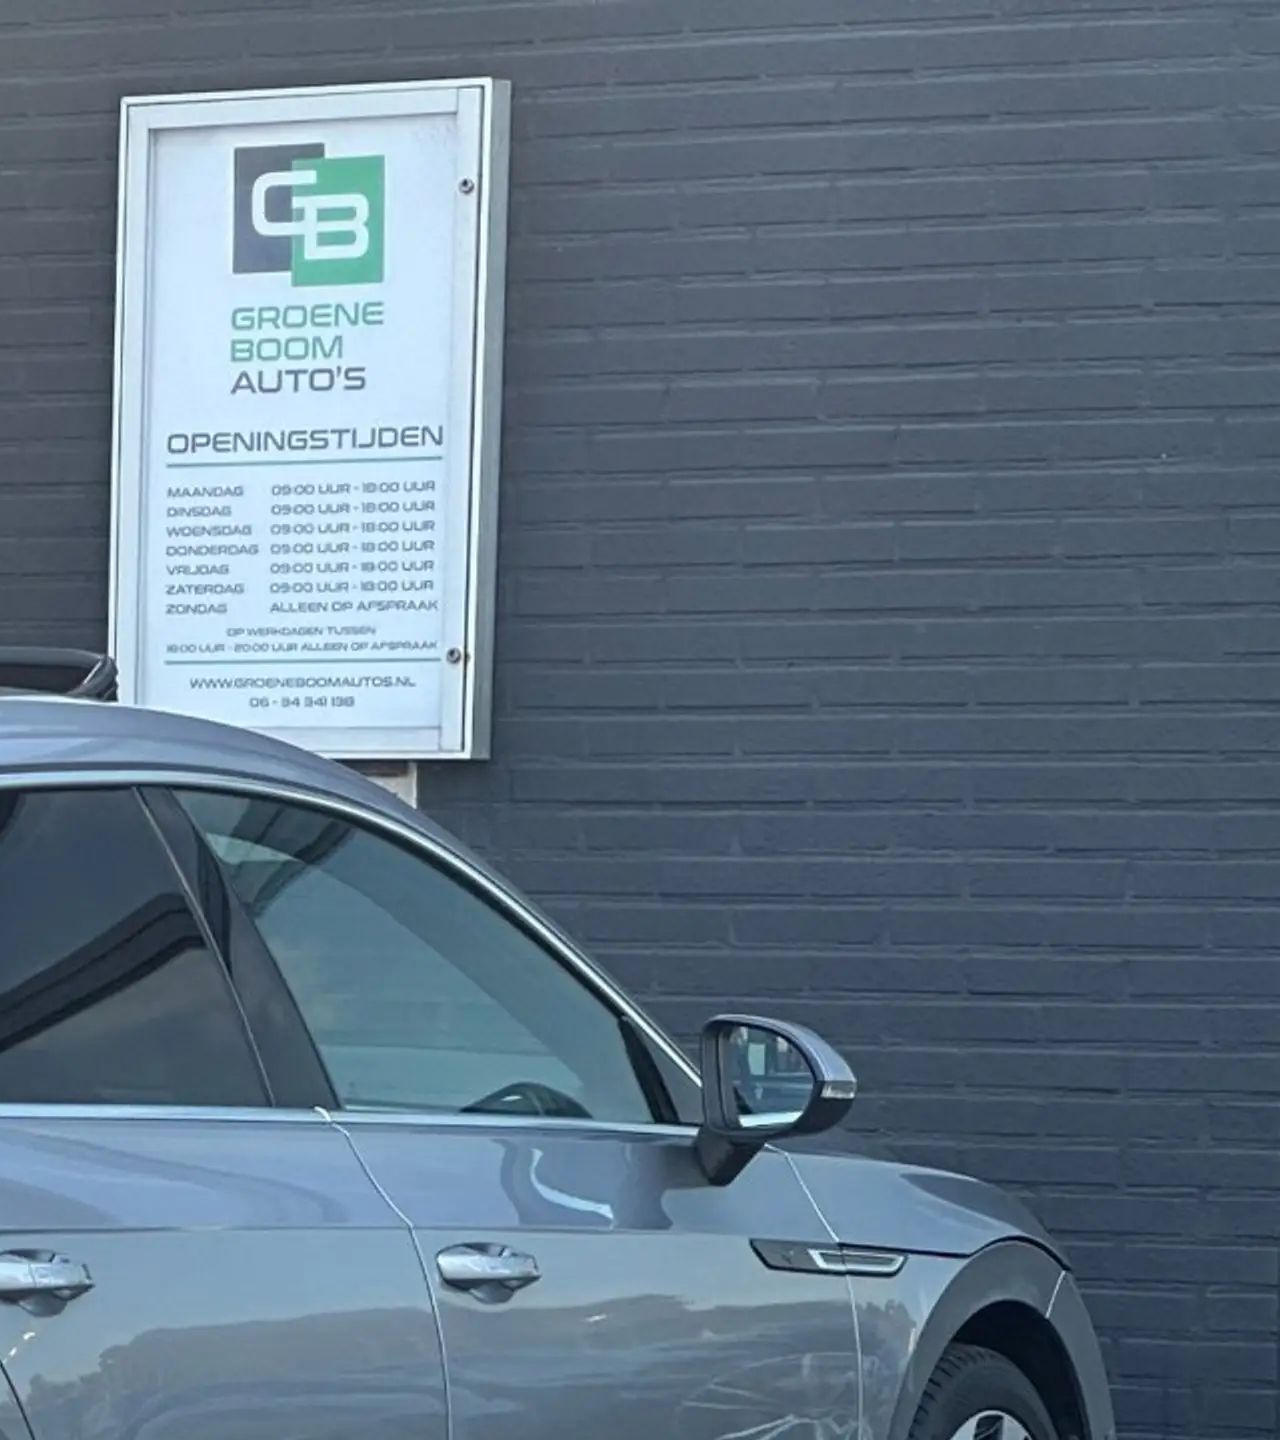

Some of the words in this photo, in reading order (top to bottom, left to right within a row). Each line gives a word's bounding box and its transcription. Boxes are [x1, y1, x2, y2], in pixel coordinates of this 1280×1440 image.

[231, 301, 384, 331] GROENE
[231, 335, 343, 362] BOOM
[230, 366, 366, 395] AUTO'S
[167, 425, 443, 454] OPENINGSTIJDEN
[167, 486, 244, 498] MAANDAG
[318, 483, 351, 494] UUR
[403, 480, 435, 492] UUR
[166, 506, 232, 517] DINSDAG
[318, 503, 350, 515] UUR
[403, 500, 435, 512] UUR
[166, 525, 252, 537] WOENSDAG
[318, 523, 350, 534] UUR
[402, 520, 435, 532] UUR
[166, 544, 259, 556] DONDERDAG
[317, 542, 349, 553] UUR
[402, 540, 435, 552] UUR
[166, 564, 229, 575] VRIJDAG
[316, 562, 349, 573] UUR
[402, 560, 434, 571] UUR
[166, 584, 244, 595] ZATERDAG
[316, 582, 349, 593] UUR
[401, 580, 434, 591] UUR
[165, 603, 227, 615] ZONDAG
[270, 602, 328, 613] ALLEEN
[331, 601, 353, 612] OP
